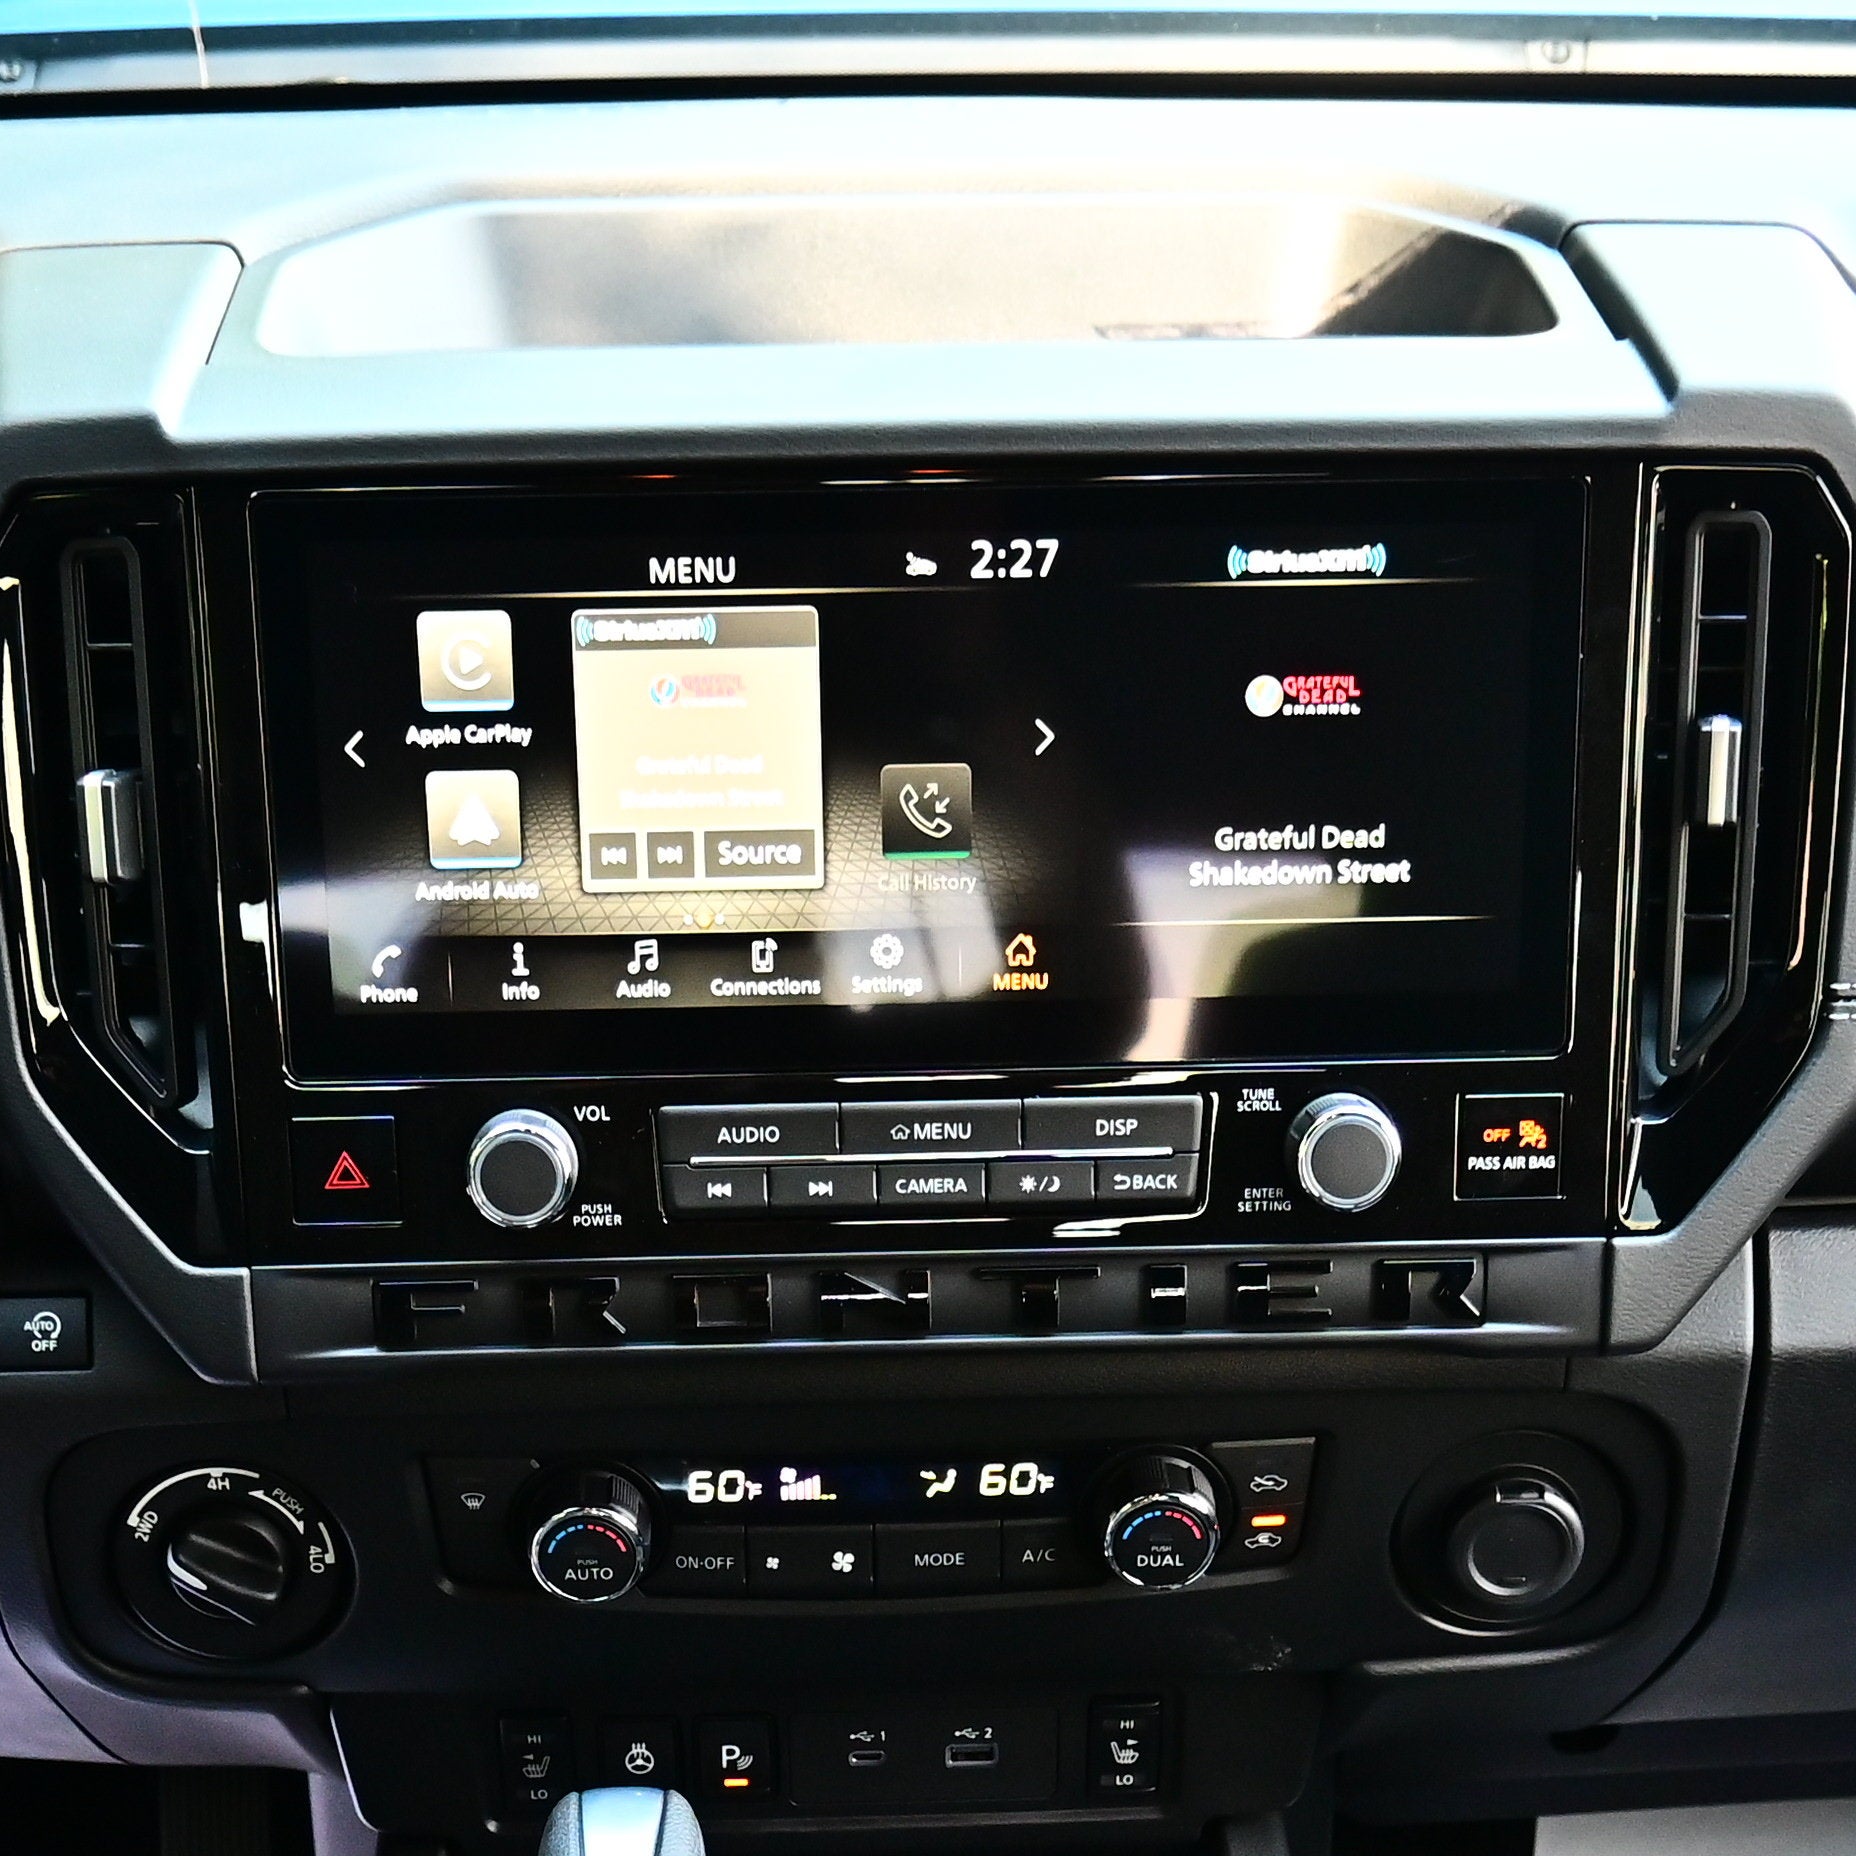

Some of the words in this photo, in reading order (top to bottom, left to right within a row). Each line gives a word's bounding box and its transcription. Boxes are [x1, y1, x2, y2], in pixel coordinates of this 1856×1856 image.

[970, 538, 1059, 580] 2:27
[648, 556, 736, 585] MENU
[1282, 675, 1362, 698] GRATEFUL
[1298, 689, 1347, 704] DEAD
[1282, 703, 1362, 716] CHANNEL
[406, 724, 461, 749] Apple
[464, 724, 532, 747] CarPlay
[1214, 825, 1316, 851] Grateful
[1321, 823, 1386, 849] Dead
[717, 841, 802, 867] Source
[1188, 860, 1332, 887] Shakedown
[1337, 857, 1411, 885] Street
[415, 880, 489, 902] Android
[492, 880, 539, 901] Auto
[878, 873, 911, 892] Call
[913, 873, 977, 896] History
[501, 979, 540, 1001] Info
[616, 977, 671, 999] Audio
[710, 974, 822, 998] Connections
[851, 973, 923, 998] Settings
[993, 971, 1048, 992] MENU
[360, 982, 418, 1004] Phone
[1242, 1088, 1276, 1101] TUNE
[573, 1106, 611, 1123] VOL
[1236, 1099, 1283, 1113] SCROLL
[717, 1126, 781, 1145] AUDIO
[913, 1123, 973, 1141] MENU
[1095, 1118, 1139, 1139] DISP
[1482, 1128, 1511, 1144] OFF
[1467, 1155, 1500, 1171] PASS
[1502, 1154, 1526, 1170] AIR
[1527, 1154, 1557, 1171] BAG
[895, 1177, 968, 1195] CAMERA
[1131, 1173, 1179, 1192] BACK
[1243, 1187, 1285, 1200] ENTER
[580, 1203, 613, 1215] PUSH
[1236, 1199, 1293, 1213] SETTING
[571, 1214, 623, 1228] POWER
[23, 1319, 55, 1333] AUTO
[31, 1339, 58, 1353] OFF
[206, 1476, 231, 1492] 4H
[271, 1486, 305, 1516] PUSH
[134, 1509, 159, 1543] 2WD
[1021, 1547, 1057, 1564] A/C
[1150, 1544, 1173, 1553] PUSH
[307, 1544, 325, 1575] 4LO
[914, 1552, 966, 1568] MODE
[1136, 1553, 1185, 1569] DUAL
[564, 1566, 614, 1582] AUTO
[1120, 1719, 1136, 1731] HI
[526, 1734, 543, 1745] HI
[721, 1744, 741, 1769] P
[1114, 1774, 1135, 1787] LO
[530, 1789, 548, 1801] LO
